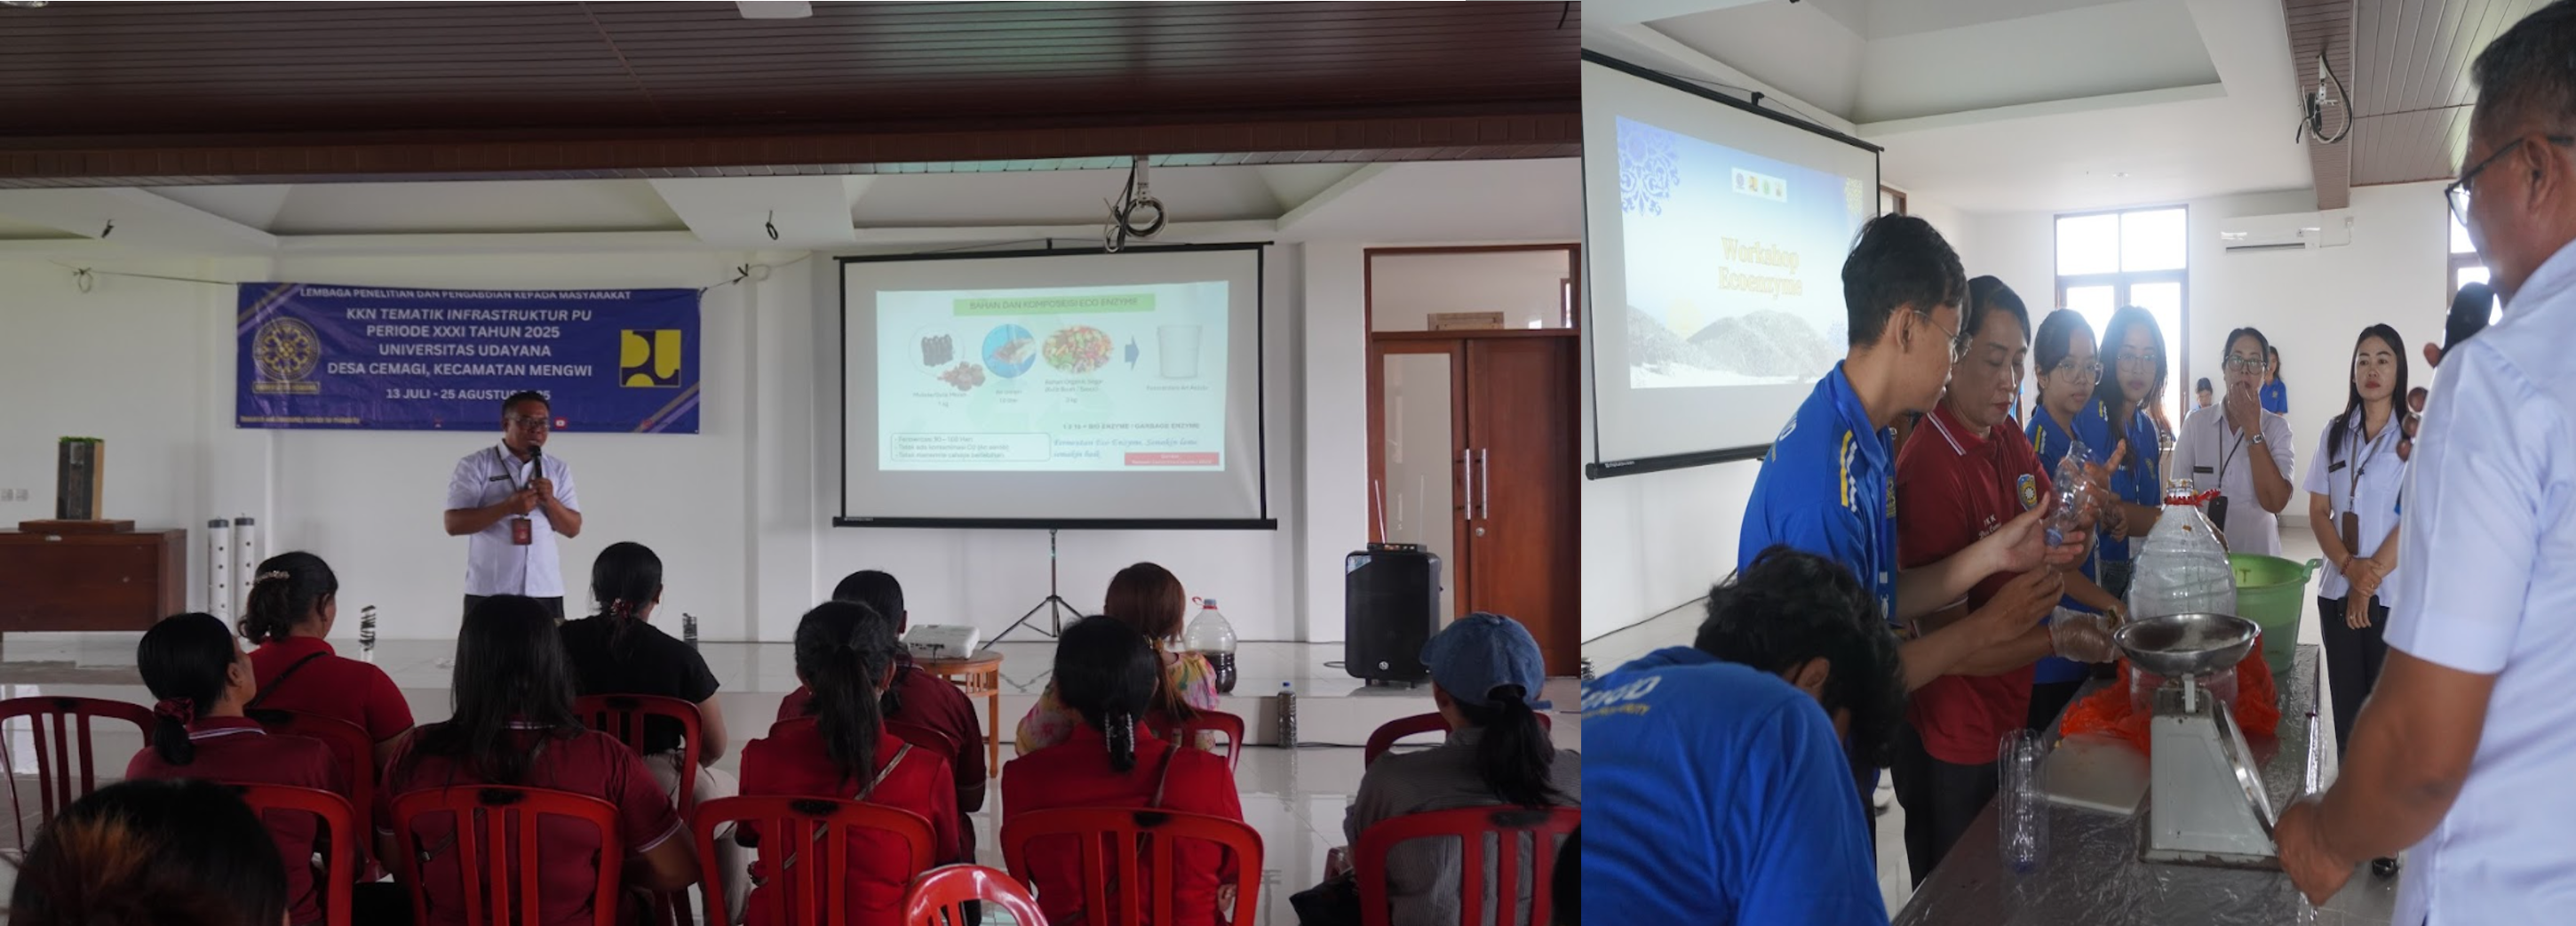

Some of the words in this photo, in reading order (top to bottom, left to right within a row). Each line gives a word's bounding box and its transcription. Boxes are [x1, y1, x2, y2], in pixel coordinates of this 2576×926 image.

[1721, 235, 1800, 275] Workshop
[1718, 266, 1803, 299] Ecoenzyme
[300, 288, 352, 297] LEMBAGA
[354, 289, 414, 298] PENELITIAN
[417, 290, 440, 299] DAN
[560, 291, 632, 299] MASYARAKAT
[969, 300, 1000, 309] BAHAN
[1002, 300, 1022, 309] DAN
[1079, 298, 1099, 307] ECO
[1101, 297, 1138, 307] ENZYME
[346, 308, 377, 320] KKN
[380, 308, 444, 320] TEMATIK
[447, 309, 568, 321] INFRASTRUKTUR
[571, 310, 592, 321] PU
[367, 325, 430, 337] PERIODE
[433, 325, 465, 337] XXXI
[469, 326, 521, 338] TAHUN
[524, 326, 561, 338] 2025
[378, 344, 475, 355] UNIVERSITAS
[478, 345, 552, 356] UDAYANA
[327, 363, 366, 374] DESA
[369, 363, 431, 377] CEMAGI,
[433, 363, 525, 375] KECAMATAN
[529, 364, 592, 376] MENGWI
[386, 388, 400, 399] 13
[402, 389, 431, 399] JULI
[441, 389, 456, 399] 25
